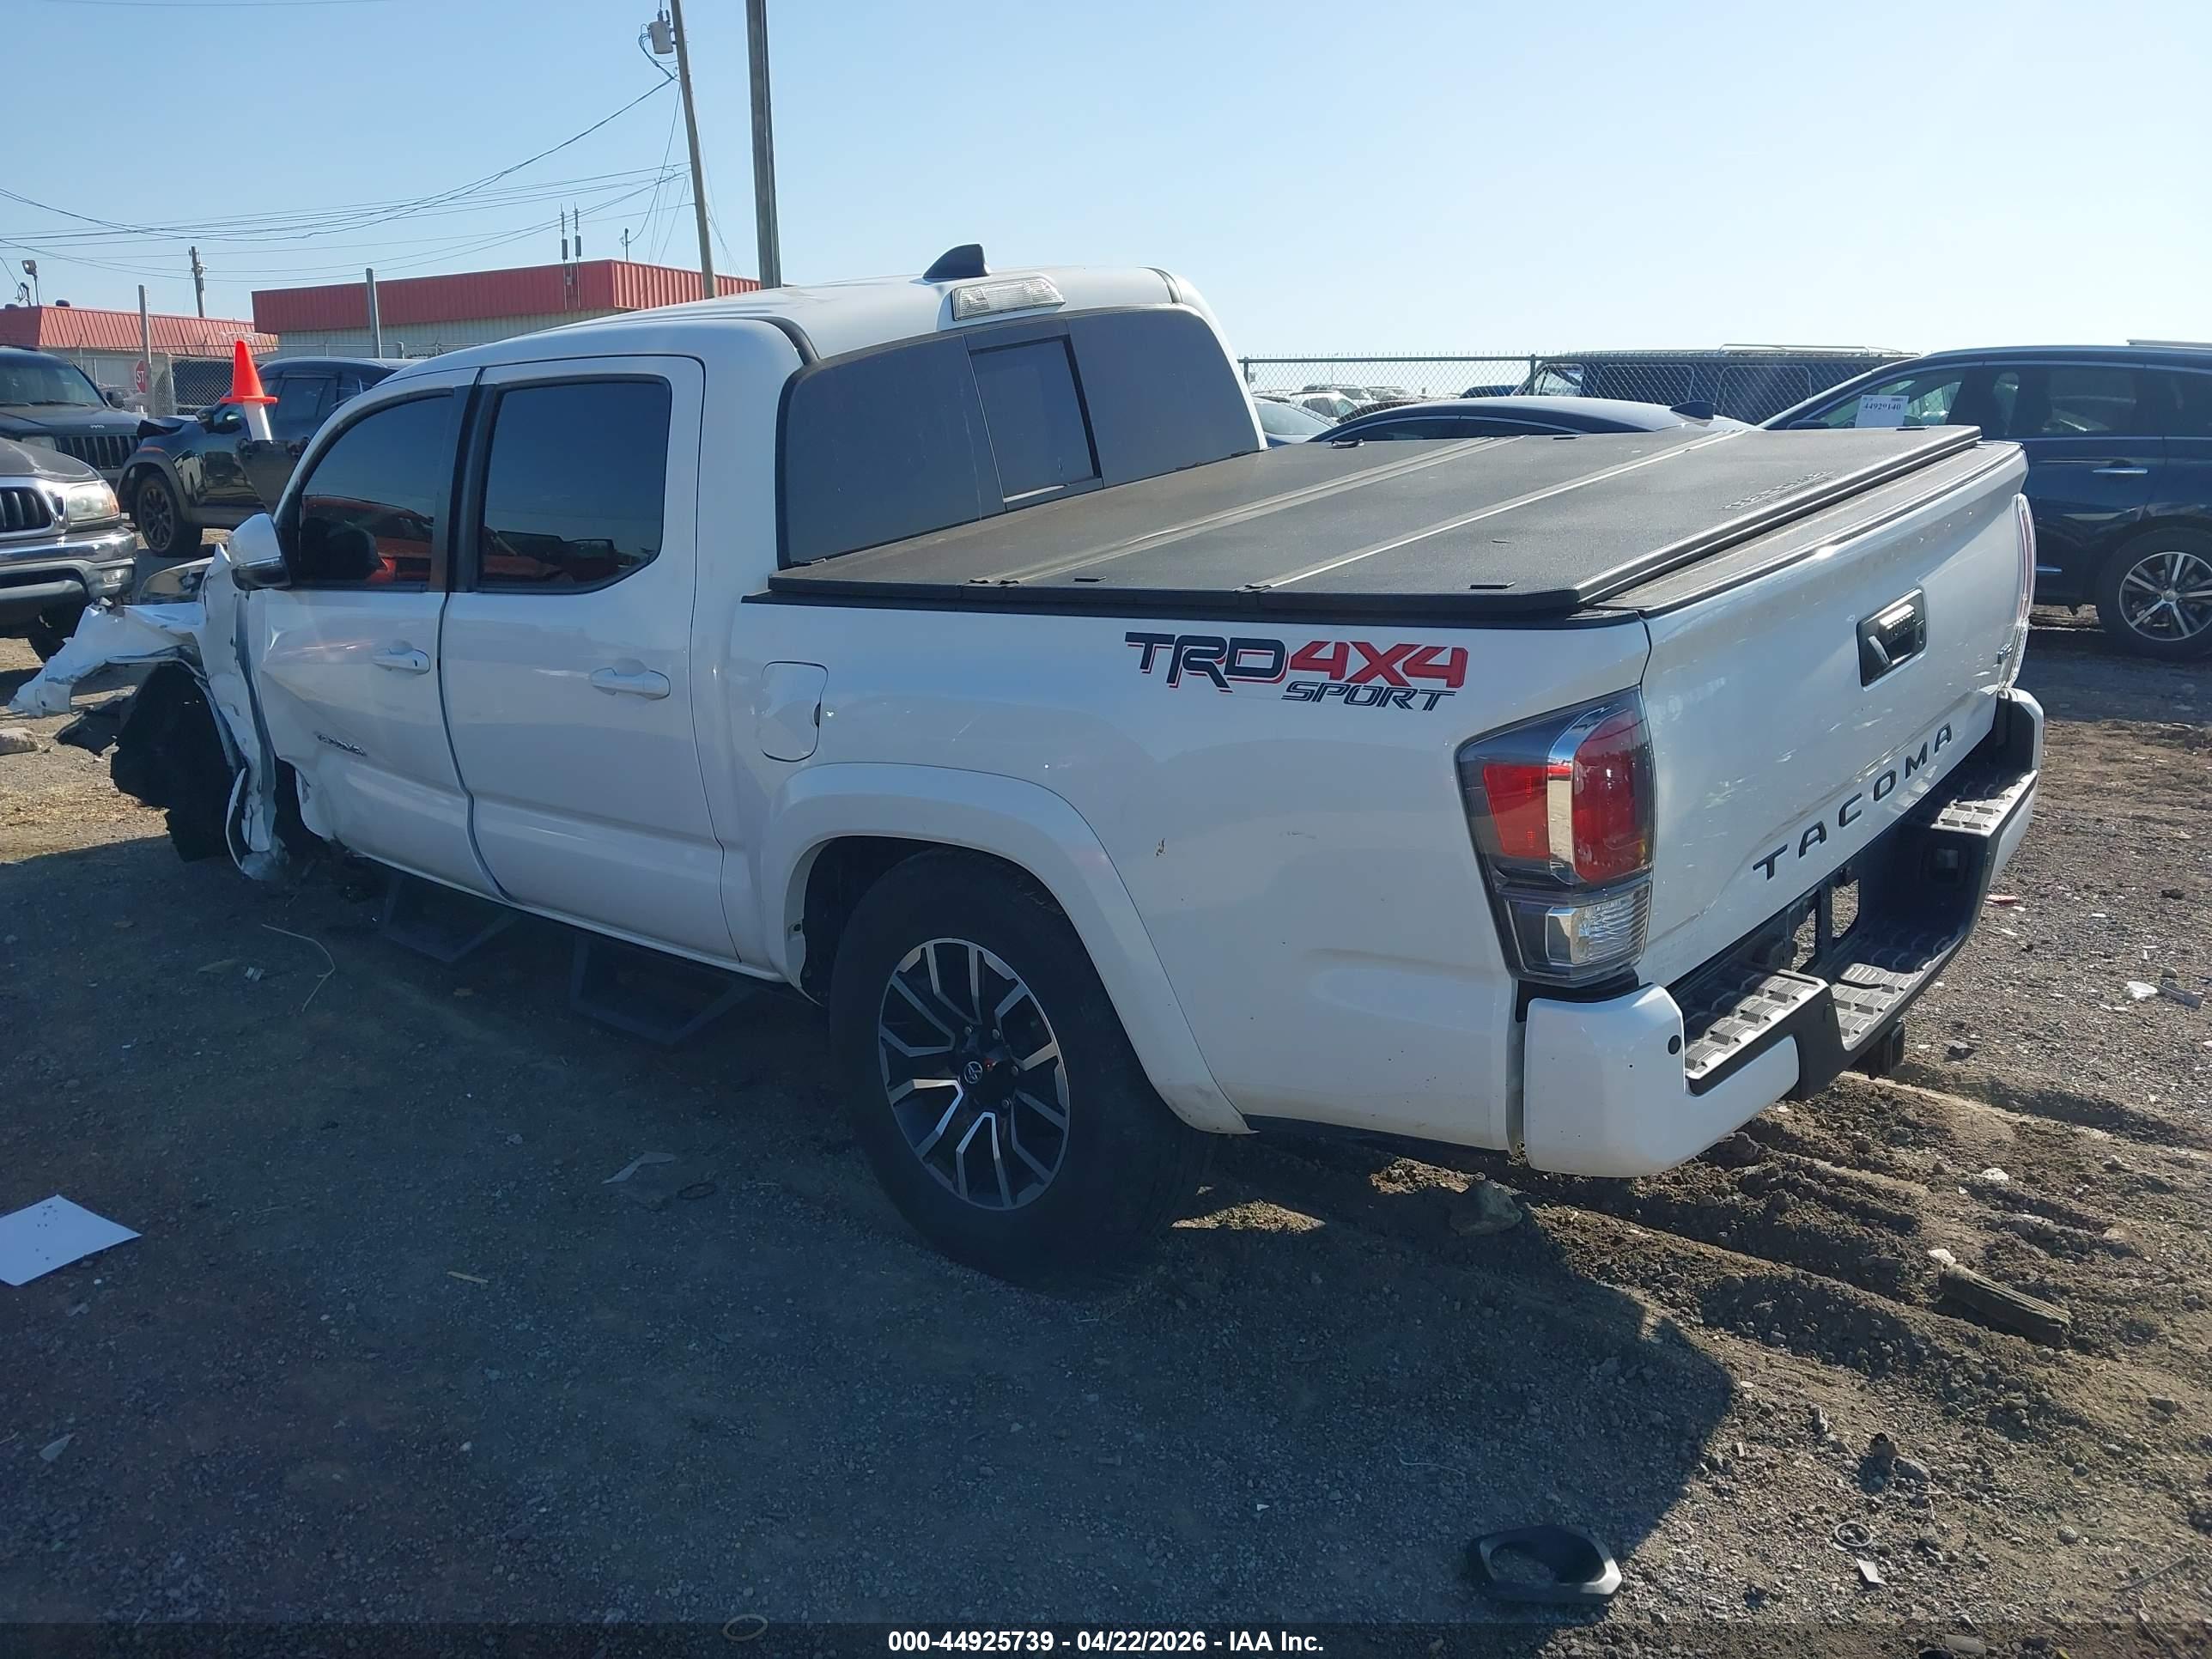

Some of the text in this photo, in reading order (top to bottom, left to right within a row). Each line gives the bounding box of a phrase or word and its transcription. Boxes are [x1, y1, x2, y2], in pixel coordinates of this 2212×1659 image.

[1125, 632, 1290, 693] TRD
[1281, 681, 1455, 712] SPORT
[1753, 722, 1953, 881] TACOMA
